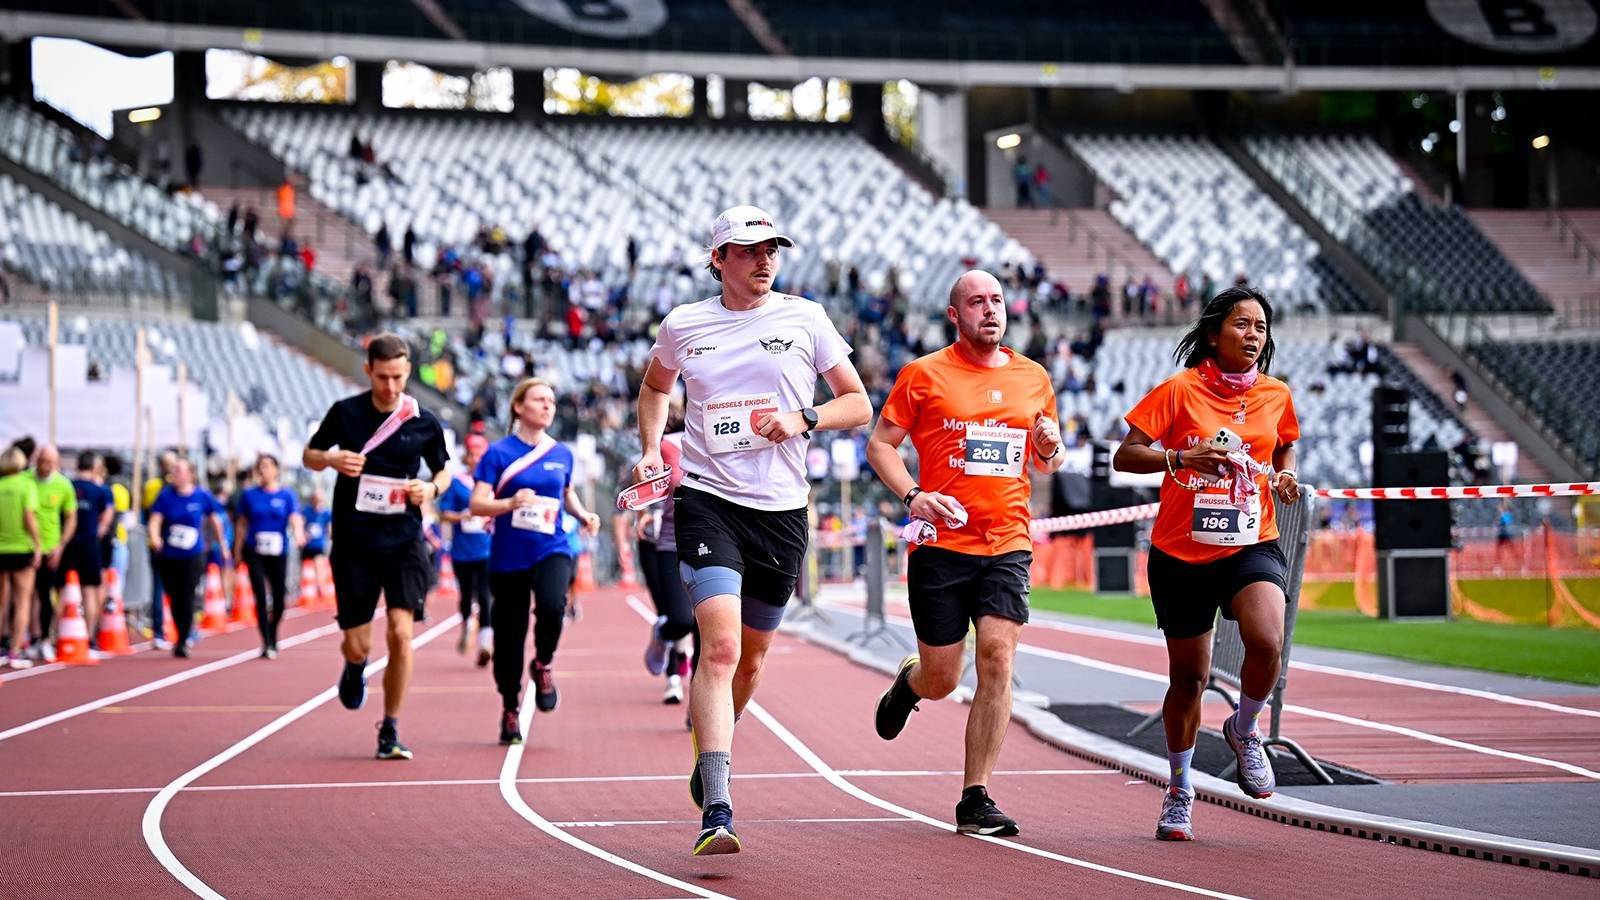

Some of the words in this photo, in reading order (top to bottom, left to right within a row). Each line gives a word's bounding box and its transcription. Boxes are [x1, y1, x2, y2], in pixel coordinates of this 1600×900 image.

[707, 401, 742, 410] BRUSSELS
[744, 398, 771, 407] EKIDEN
[713, 421, 740, 435] 128
[971, 430, 1002, 438] BRUSSELS
[972, 448, 1000, 460] 203
[1013, 451, 1021, 462] 2
[1202, 516, 1229, 530] 196
[1246, 518, 1256, 529] 2
